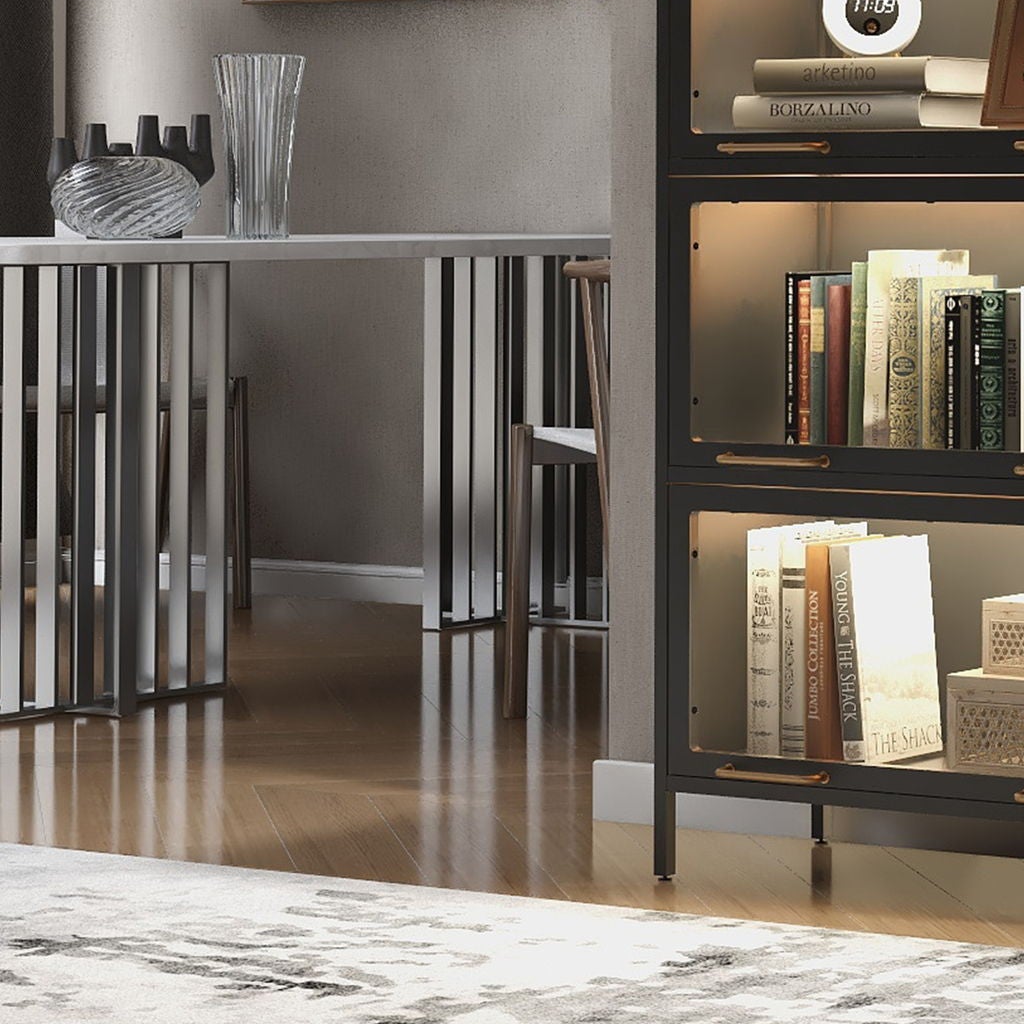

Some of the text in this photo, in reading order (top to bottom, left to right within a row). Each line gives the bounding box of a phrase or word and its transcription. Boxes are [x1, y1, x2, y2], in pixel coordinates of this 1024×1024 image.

[769, 102, 872, 117] BORZALINO
[871, 340, 883, 372] DAYS
[807, 590, 819, 721] JUMBO COLLECTION
[834, 570, 858, 723] YOUNG THE SHACK
[872, 731, 898, 756] THE
